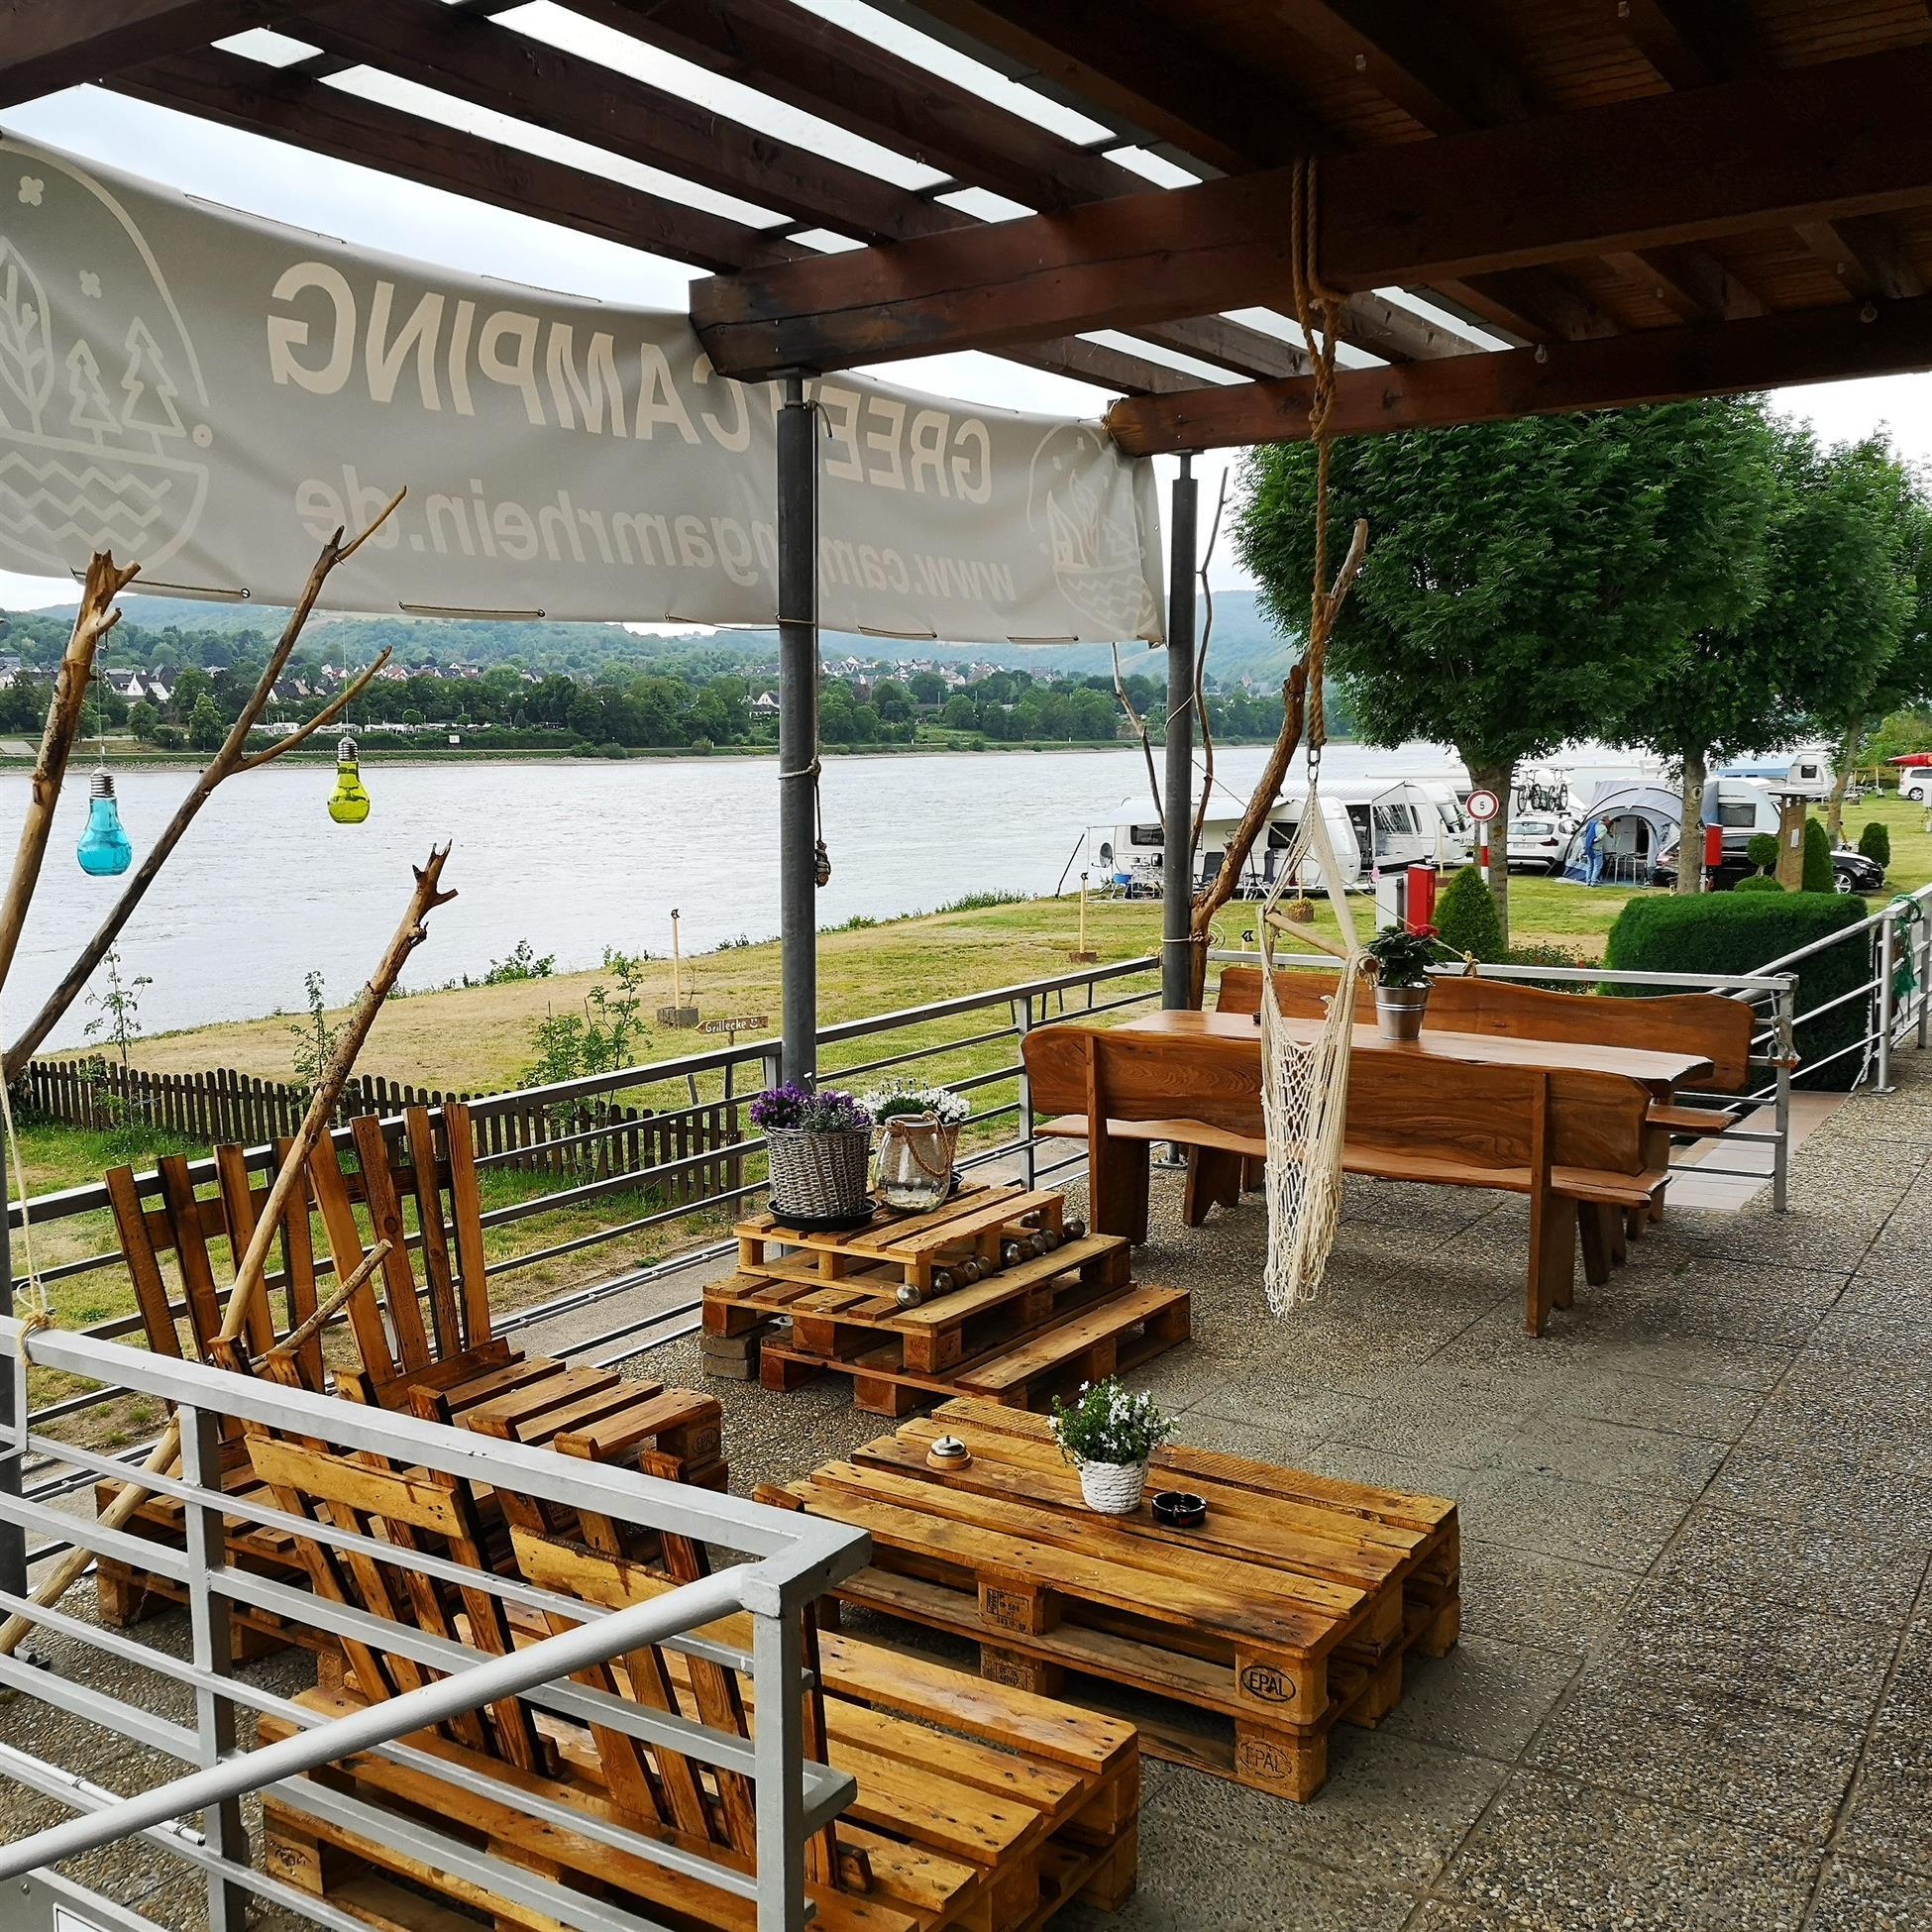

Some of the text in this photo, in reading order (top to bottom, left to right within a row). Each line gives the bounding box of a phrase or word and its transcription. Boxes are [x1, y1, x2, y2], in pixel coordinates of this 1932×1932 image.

[1479, 801, 1486, 810] 5
[704, 1019, 747, 1033] Grillecke
[1248, 1670, 1288, 1698] EPAL
[1244, 1744, 1287, 1773] EPAL
